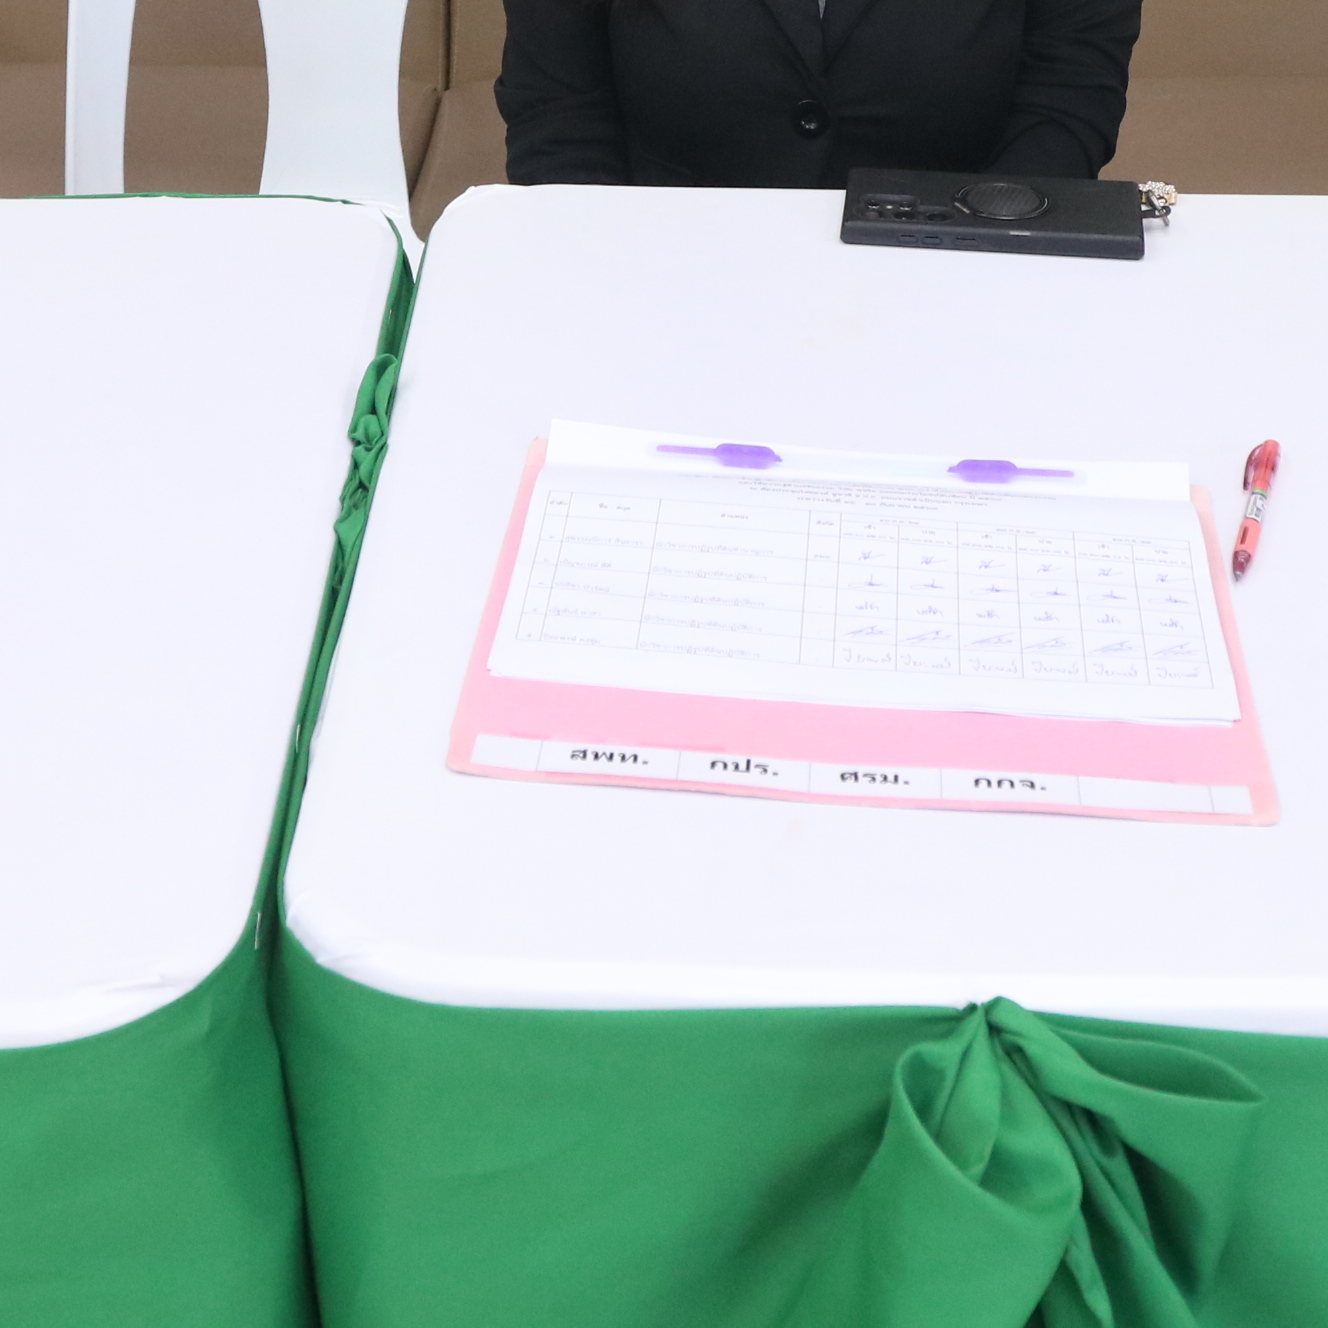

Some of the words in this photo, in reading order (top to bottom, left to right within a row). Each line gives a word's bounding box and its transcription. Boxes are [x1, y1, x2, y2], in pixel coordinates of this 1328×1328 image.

[570, 748, 649, 765] สพท.
[710, 758, 779, 777] กปร.
[974, 777, 1047, 791] กกจ.
